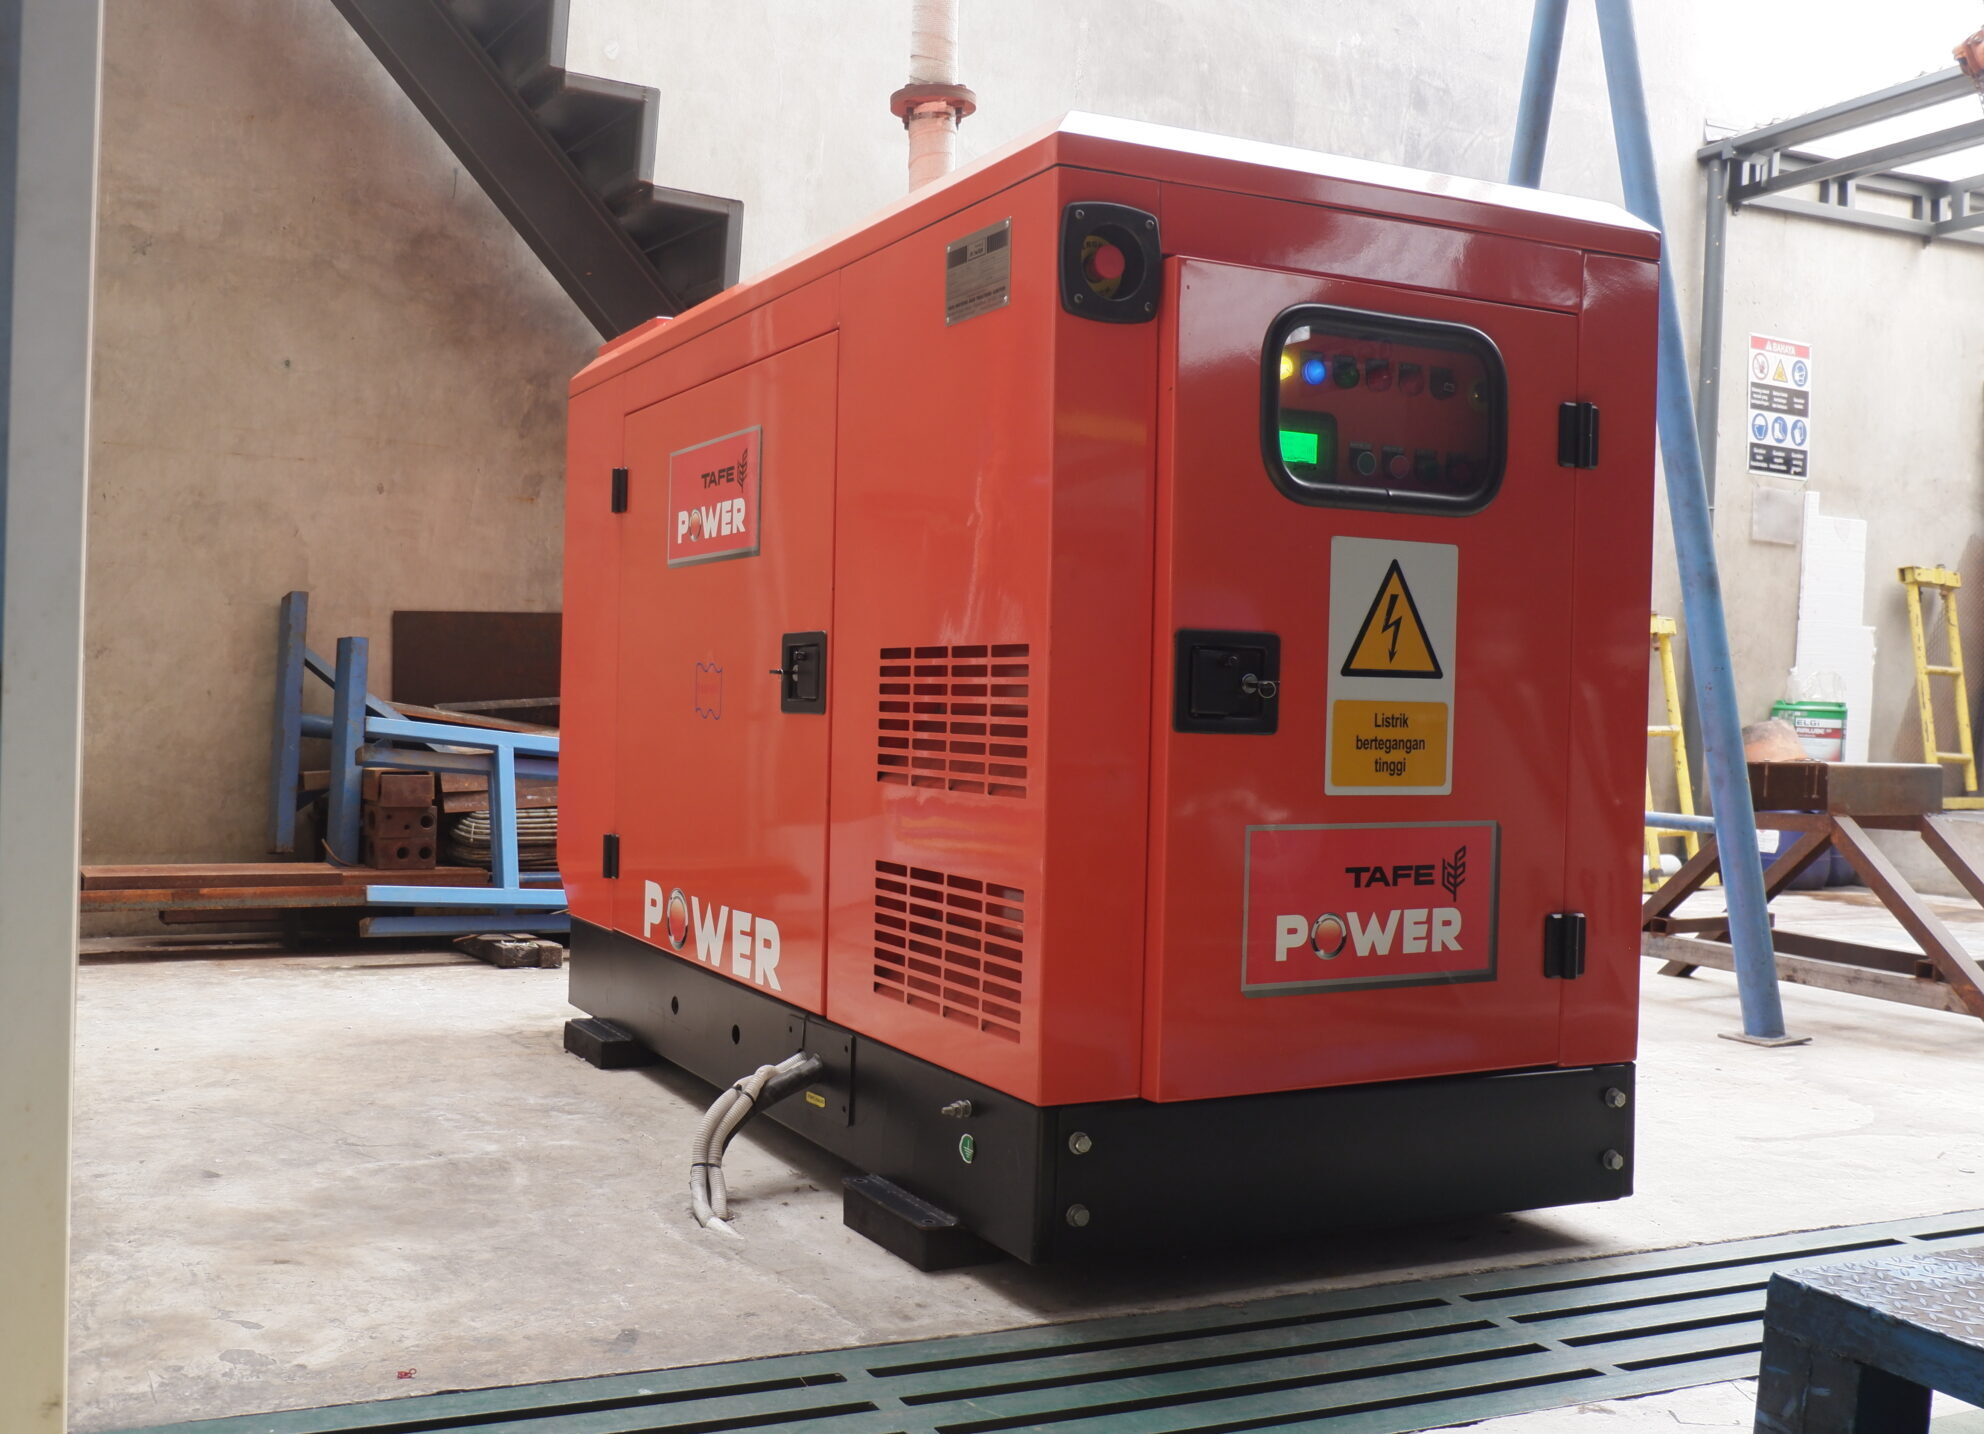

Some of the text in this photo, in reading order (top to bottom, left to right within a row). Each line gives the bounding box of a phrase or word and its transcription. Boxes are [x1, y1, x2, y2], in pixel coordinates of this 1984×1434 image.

[701, 466, 735, 489] TAFE
[677, 497, 746, 544] POWER
[1374, 713, 1409, 728] Listrik
[1356, 735, 1426, 754] bertegangan
[1375, 758, 1407, 776] tinggi
[1345, 864, 1435, 888] TAFE
[643, 879, 782, 992] POWER
[1275, 907, 1463, 962] POWER
